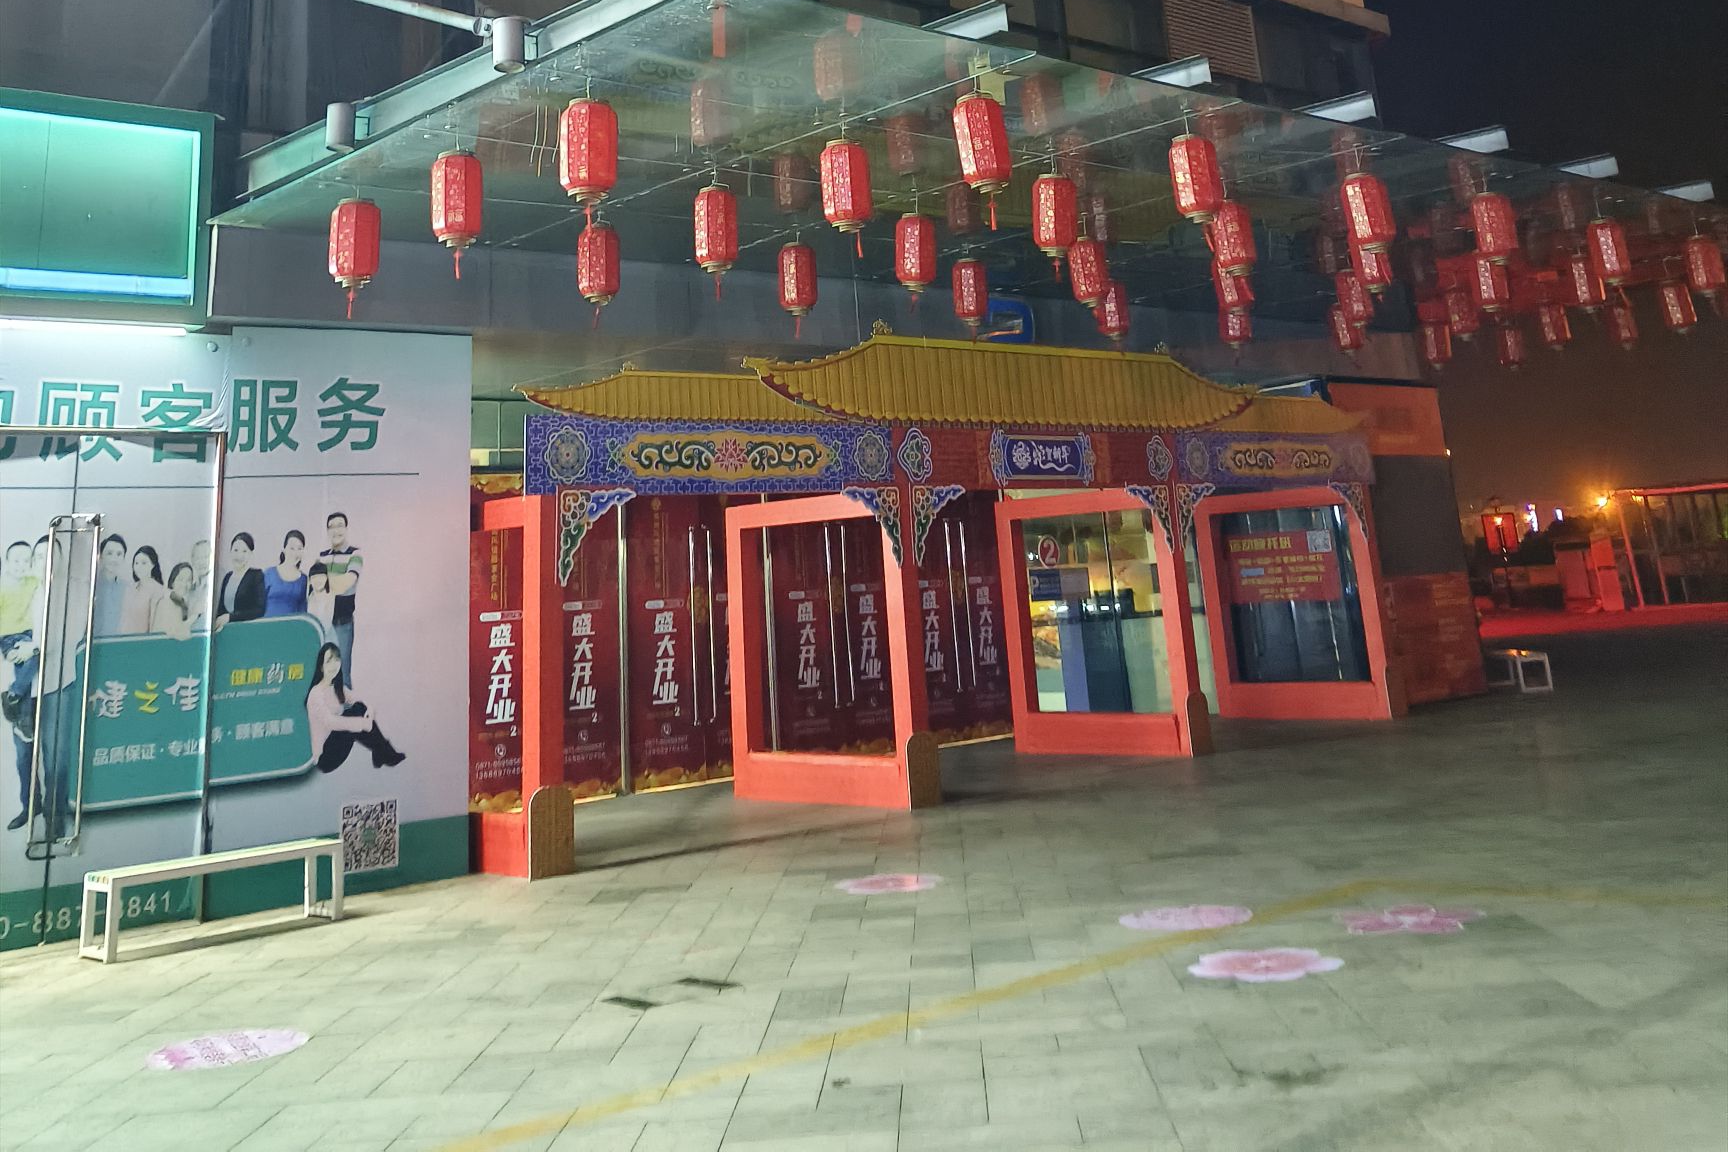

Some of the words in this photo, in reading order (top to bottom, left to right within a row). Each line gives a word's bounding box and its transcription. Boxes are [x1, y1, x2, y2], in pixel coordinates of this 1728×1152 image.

[1043, 539, 1057, 564] 2
[485, 623, 516, 724] 盛大开业
[569, 613, 596, 710] 盛大开业
[652, 611, 679, 705] 盛大开业
[797, 601, 820, 689] 盛大开业
[859, 593, 882, 680] 盛大开业
[89, 674, 201, 719] 健之佳
